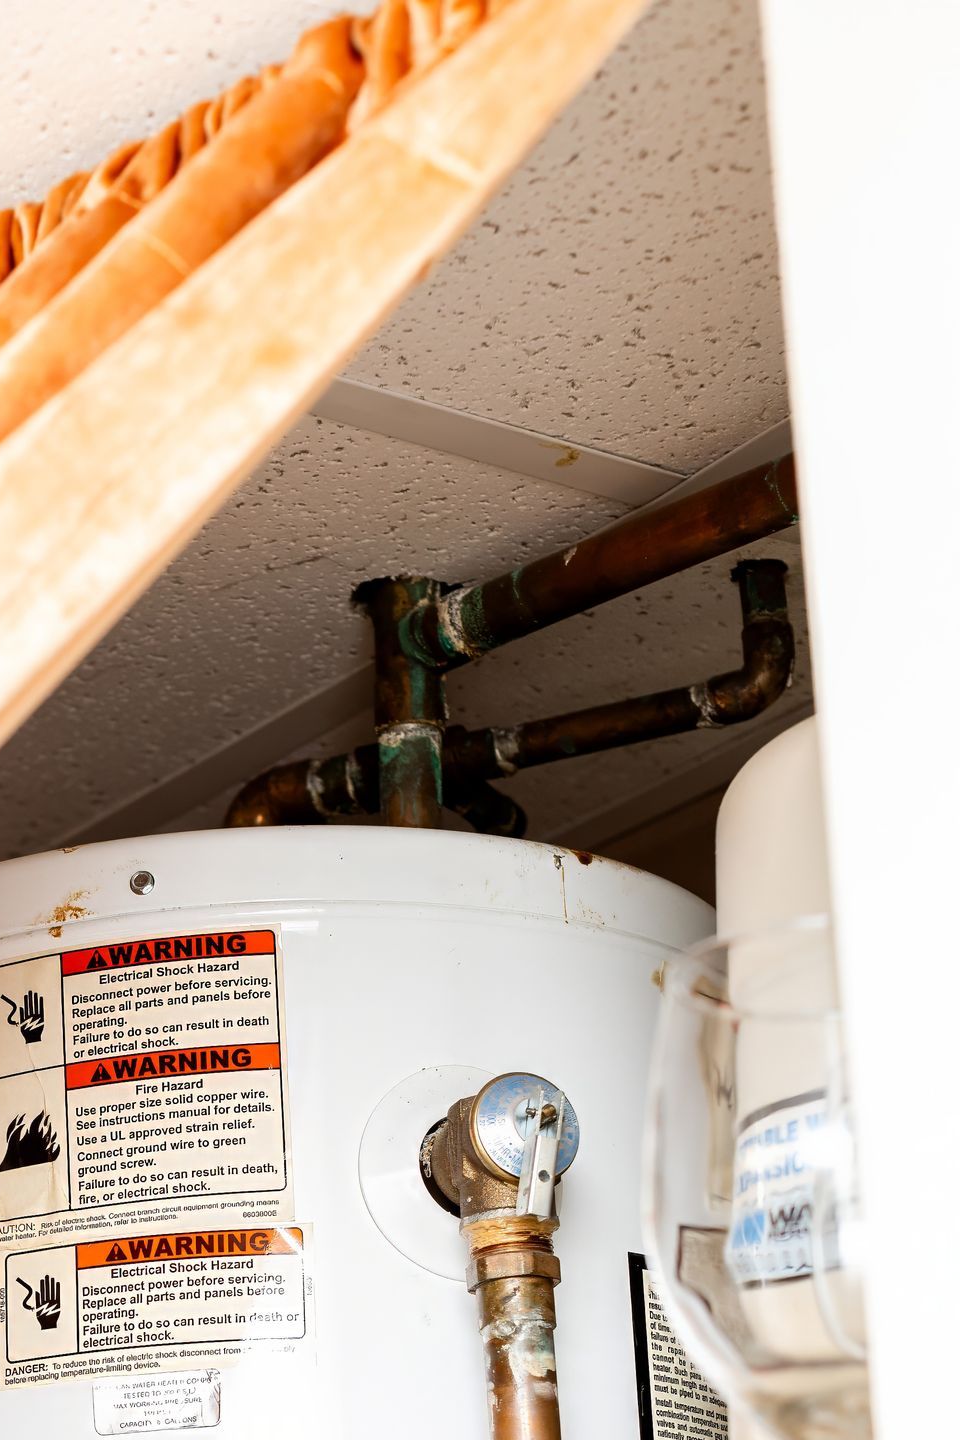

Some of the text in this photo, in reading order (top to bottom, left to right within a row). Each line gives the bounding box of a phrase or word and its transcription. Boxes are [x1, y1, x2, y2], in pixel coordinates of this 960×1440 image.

[108, 934, 247, 966] WARNING
[99, 961, 239, 984] Electrical Shock Hazard
[71, 977, 271, 1005] Disconnect power before servicing.
[72, 989, 270, 1018] Replace all parts and panels before
[72, 1017, 127, 1033] operating.
[72, 1015, 269, 1045] Failure to do so can result in death
[73, 1036, 178, 1058] or electrical shock.
[113, 1048, 252, 1079] WARNING
[135, 1078, 203, 1095] Fire Hazard
[75, 1090, 268, 1117] Use proper size solid copper wire.
[76, 1102, 274, 1130] See instructions manual for details.
[76, 1135, 97, 1146] Use
[110, 1130, 125, 1141] UL
[128, 1123, 182, 1141] approved
[185, 1121, 218, 1133] strain
[222, 1118, 254, 1130] relief.
[77, 1137, 246, 1161] Connect ground wire to green
[77, 1158, 156, 1178] ground screw.
[78, 1163, 277, 1191] Failure to do so can result in death,
[78, 1181, 210, 1205] fire, or electrical shock.
[127, 1231, 270, 1261] WARNING
[110, 1259, 253, 1278] Electrical Shock Hazard
[82, 1273, 285, 1297] Disconnect power before servicing.
[82, 1285, 284, 1310] Replace all parts and panels before
[82, 1309, 138, 1323] operating.
[82, 1323, 120, 1336] Failure
[123, 1321, 135, 1331] to
[137, 1319, 153, 1330] do
[155, 1319, 170, 1328] so
[173, 1317, 194, 1327] can
[197, 1313, 232, 1325] result
[234, 1313, 246, 1323] in
[286, 1313, 299, 1321] or
[82, 1330, 174, 1348] electrical shock.
[5, 1363, 48, 1377] DANGER:
